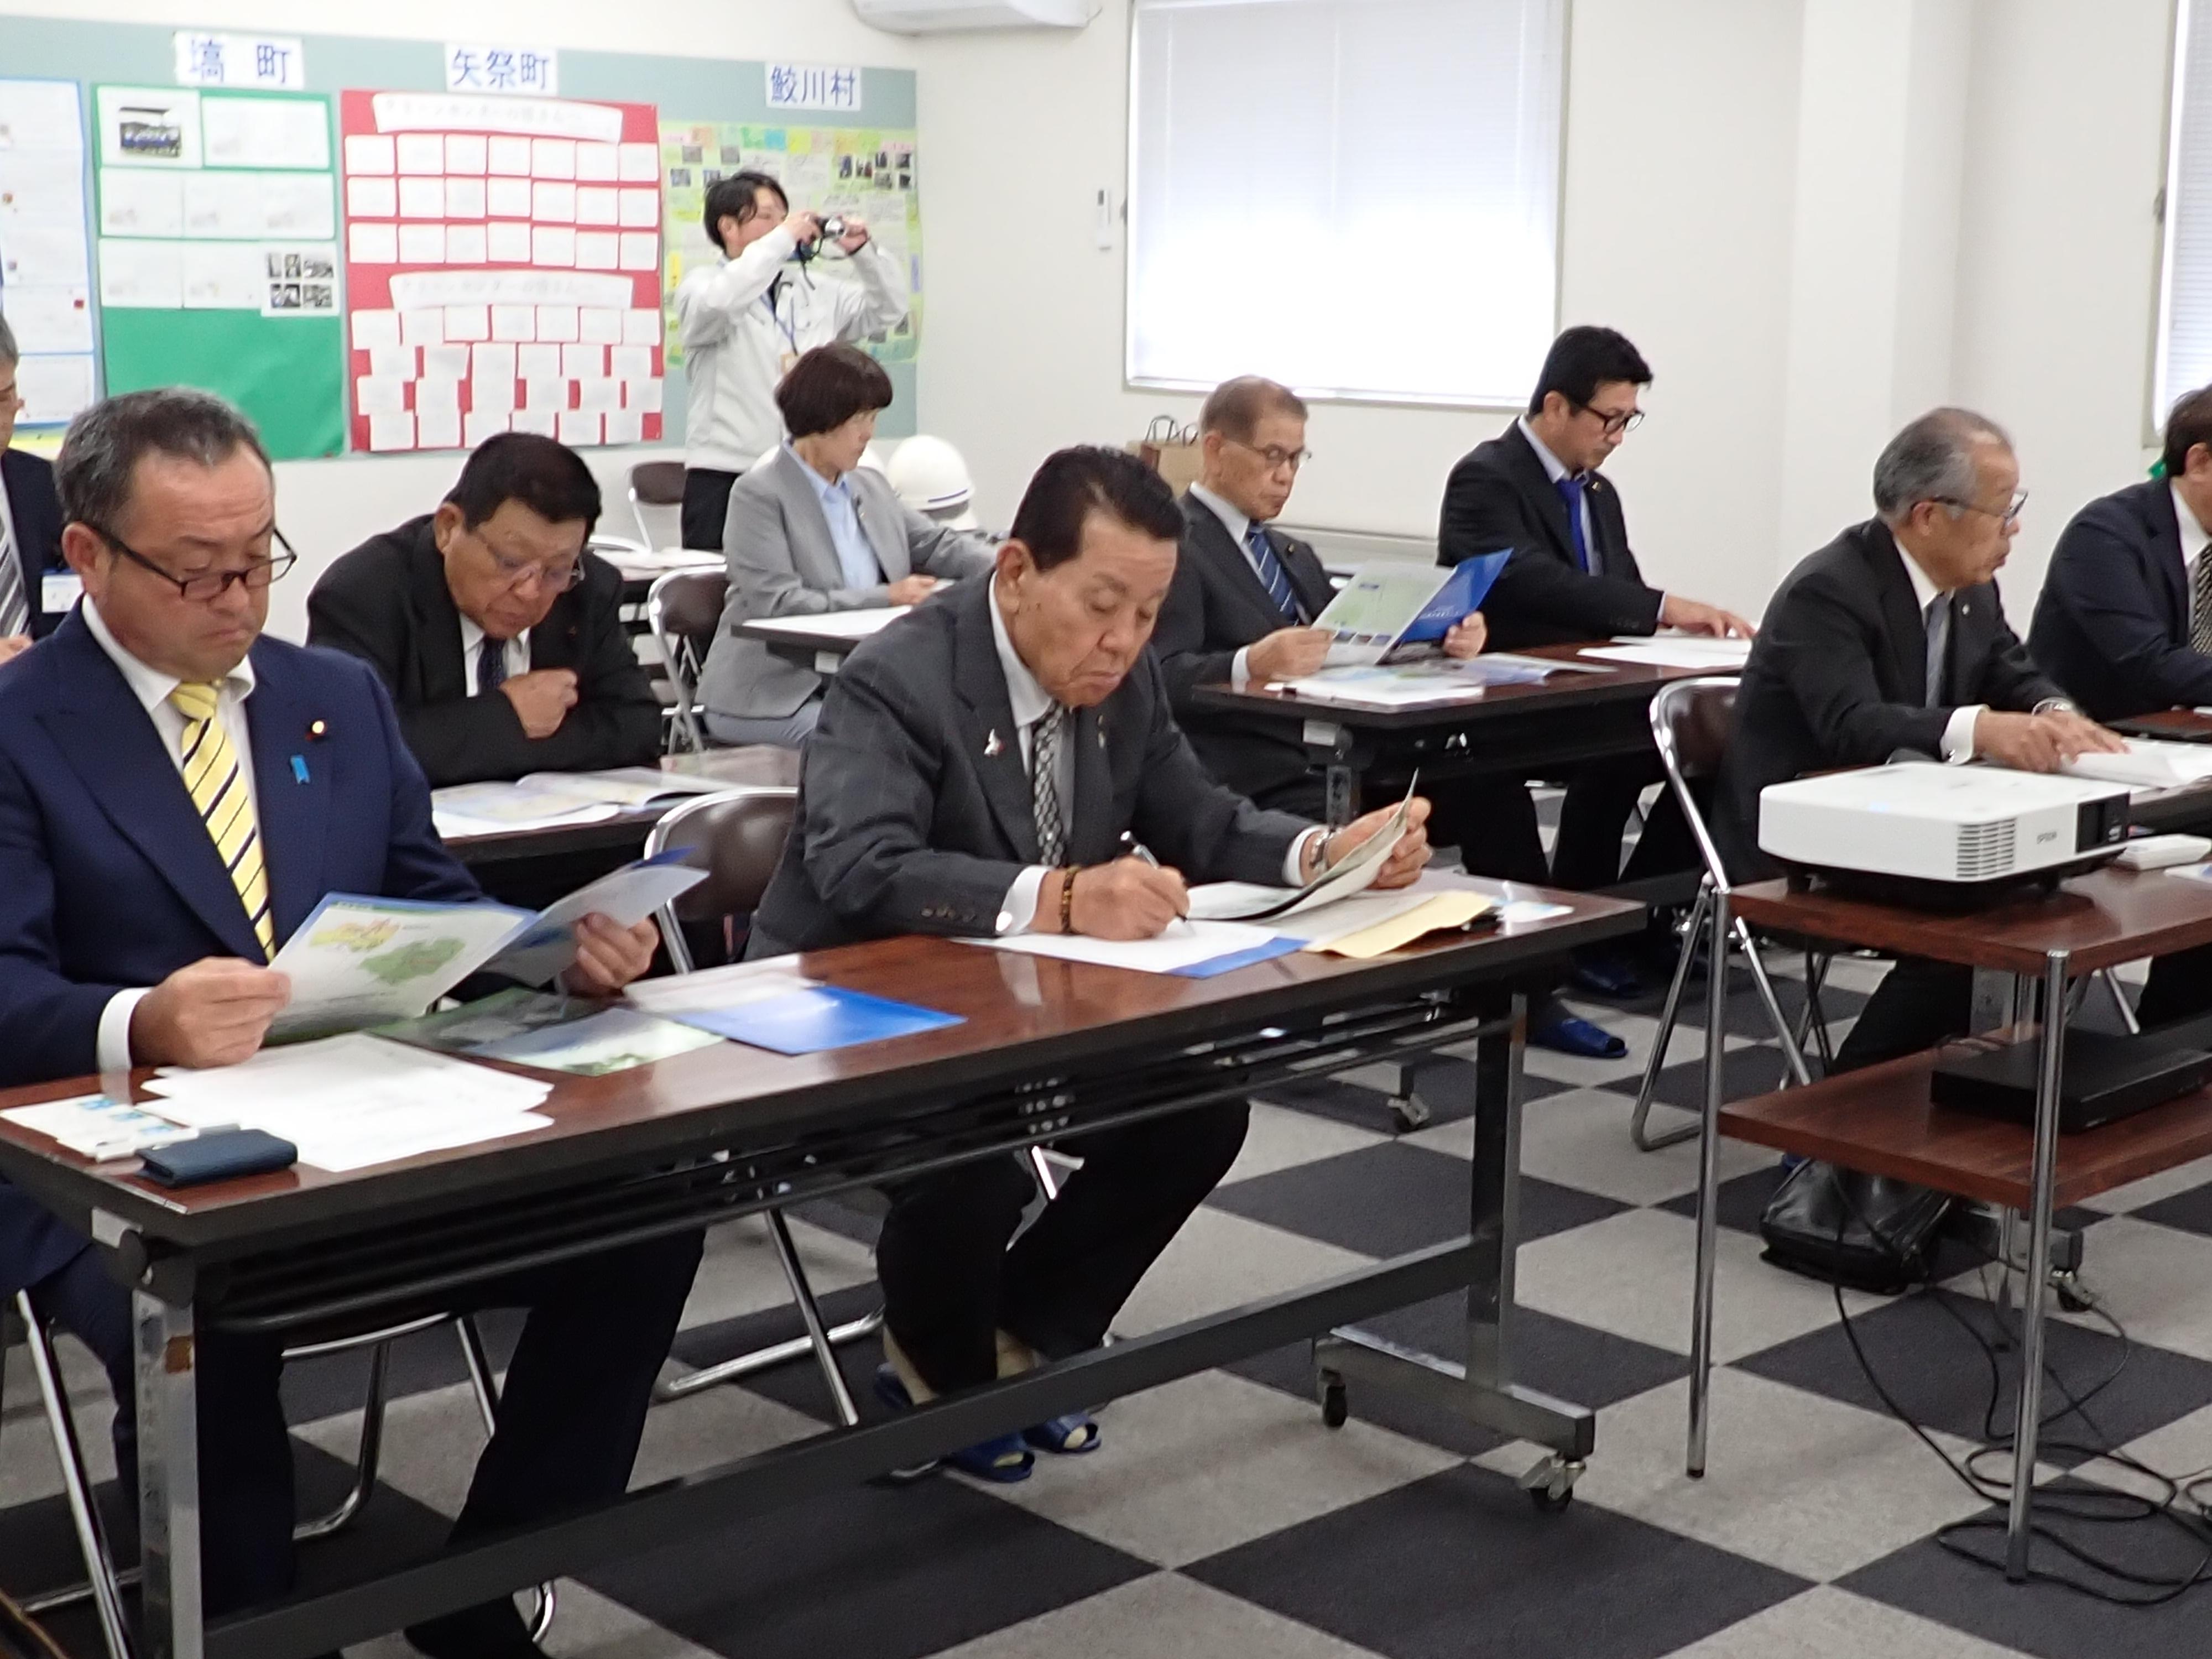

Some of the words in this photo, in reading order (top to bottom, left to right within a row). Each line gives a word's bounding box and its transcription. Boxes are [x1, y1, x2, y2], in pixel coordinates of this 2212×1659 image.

[452, 49, 549, 89] 矢祭町
[771, 66, 855, 106] 鮫川村
